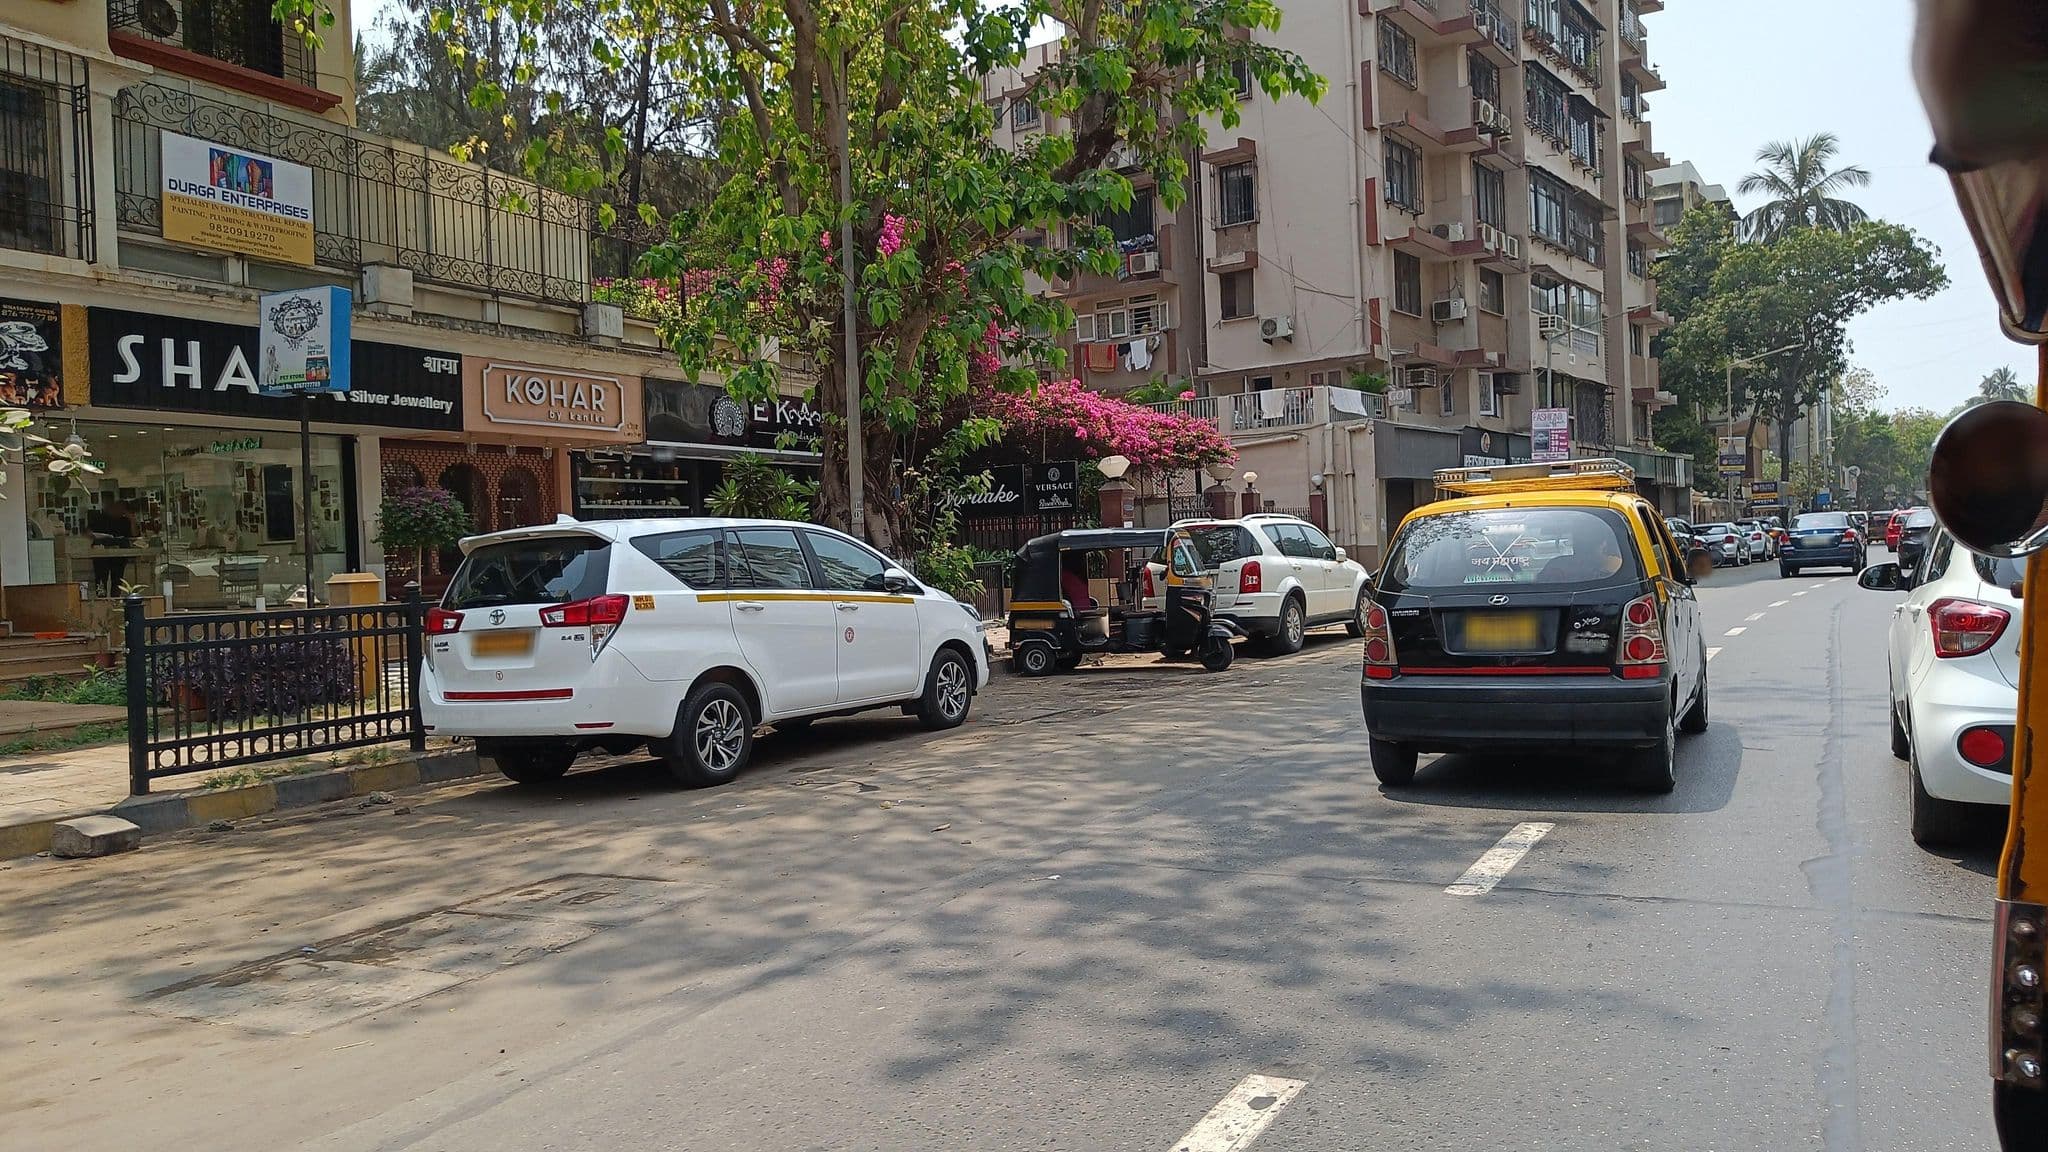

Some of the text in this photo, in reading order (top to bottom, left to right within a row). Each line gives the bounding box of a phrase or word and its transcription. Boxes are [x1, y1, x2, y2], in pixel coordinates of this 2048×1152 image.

[168, 178, 310, 220] DURGA ENTERPRISES
[169, 195, 209, 208] SPECIALIST
[220, 205, 238, 214] CIVIL
[208, 222, 276, 243] 9820919270
[350, 390, 454, 415] Silver Jewellery
[505, 374, 607, 412] KOHAR
[548, 410, 562, 421] by
[1035, 482, 1073, 492] VERSACE
[1471, 557, 1489, 567] जय
